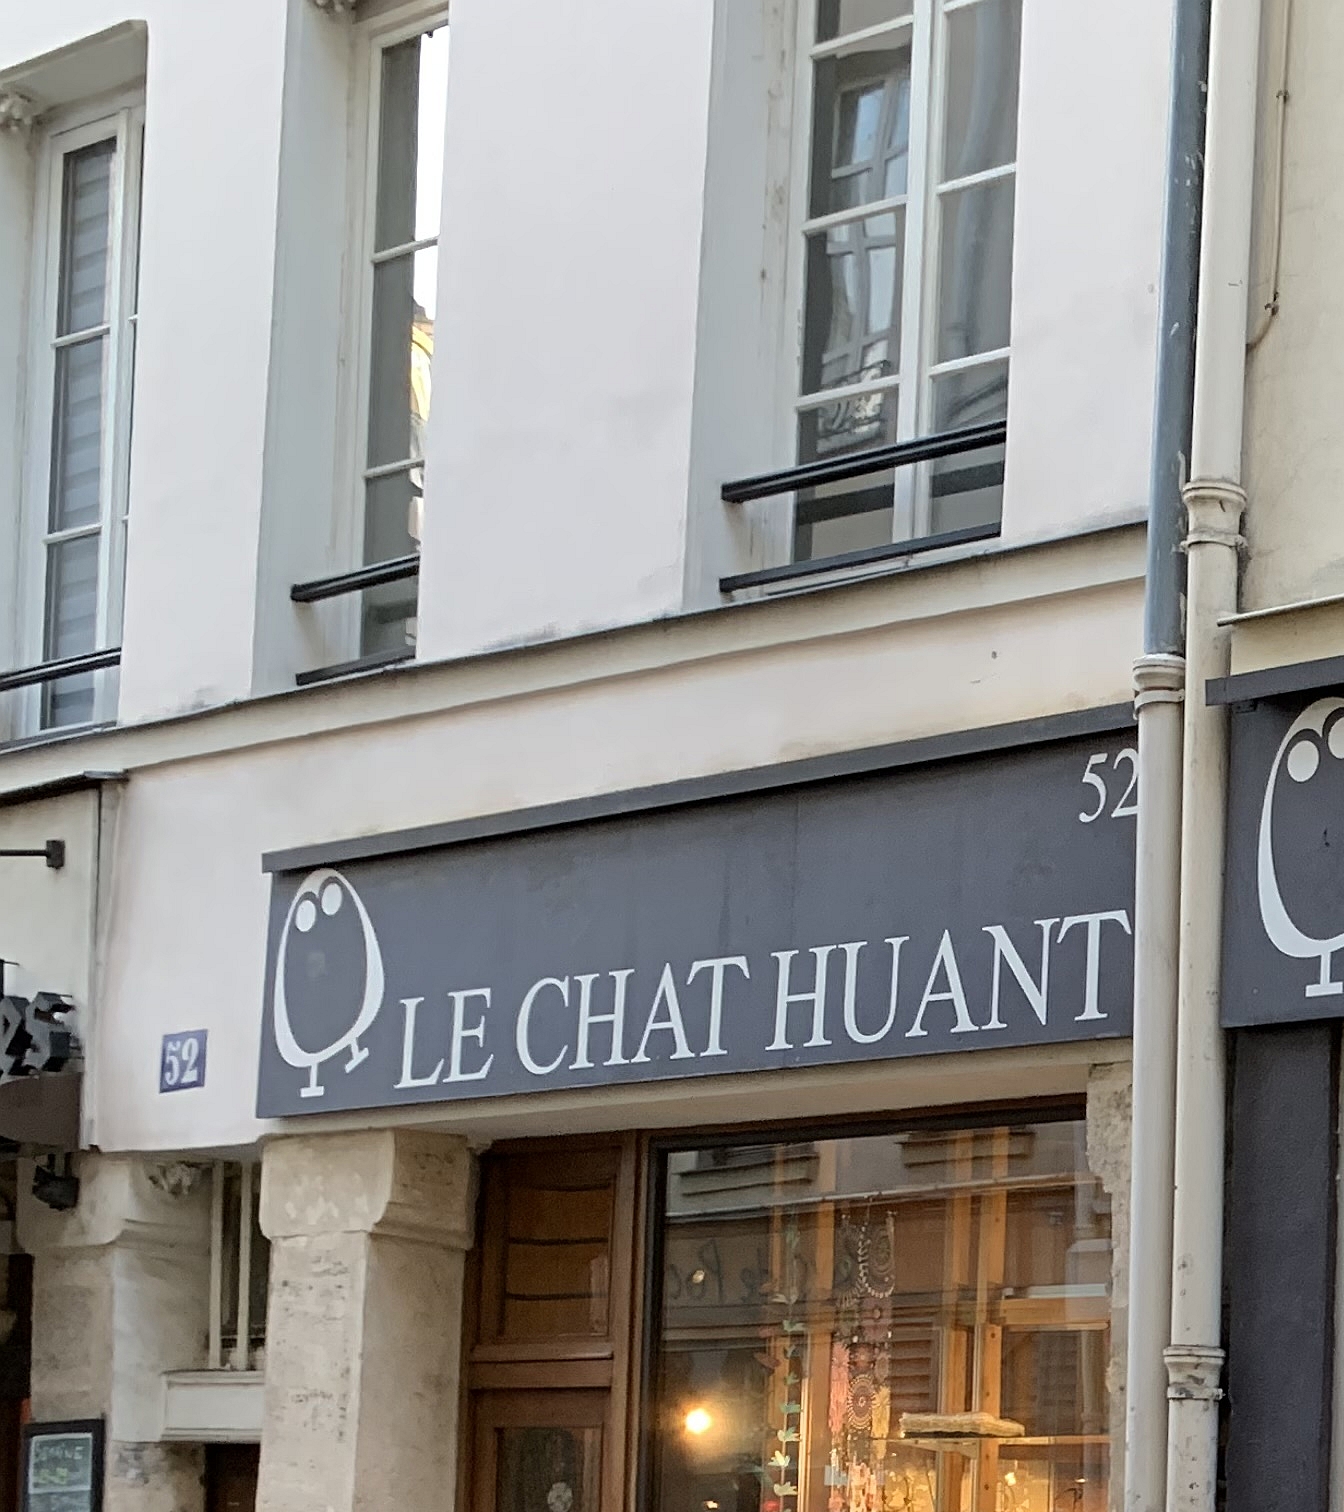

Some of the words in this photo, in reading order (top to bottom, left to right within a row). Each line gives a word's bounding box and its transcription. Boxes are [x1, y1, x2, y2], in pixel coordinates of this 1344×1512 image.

[1078, 747, 1138, 823] 52
[393, 987, 494, 1089] LE
[515, 955, 751, 1075] CHAT
[764, 909, 1133, 1052] HUANT
[164, 1037, 199, 1086] 52
